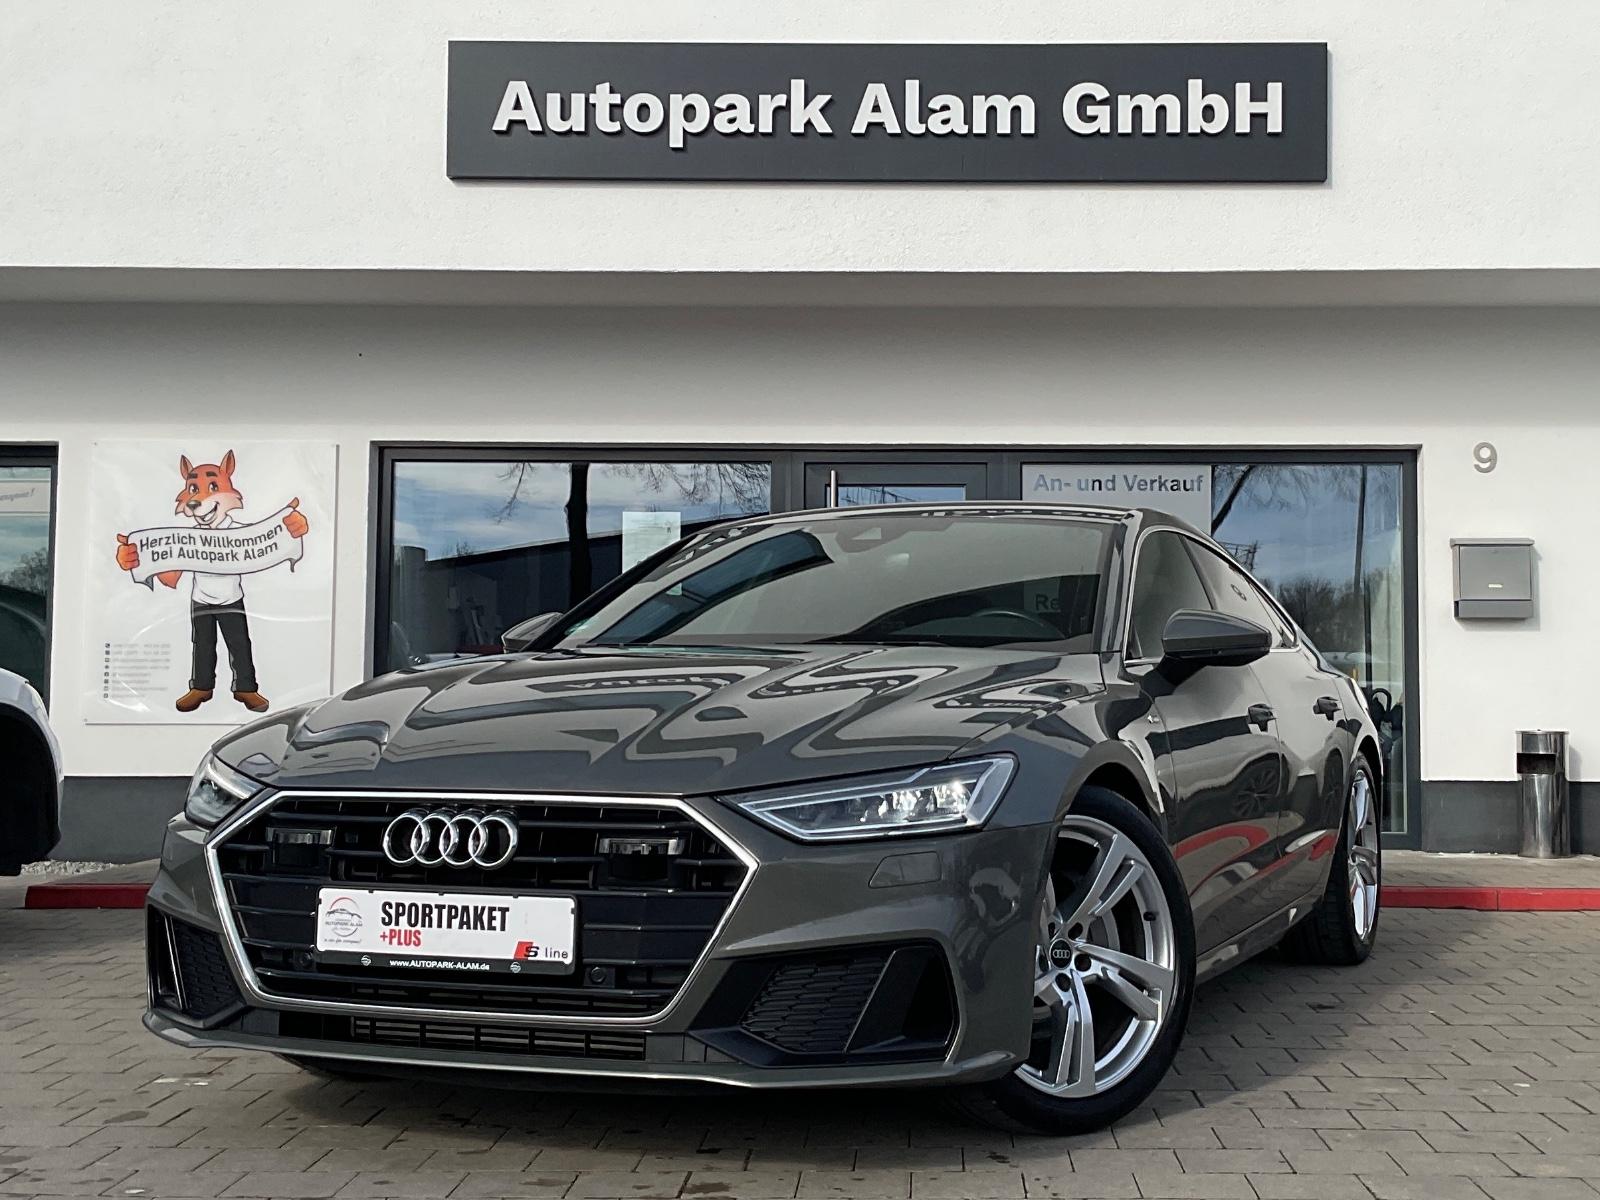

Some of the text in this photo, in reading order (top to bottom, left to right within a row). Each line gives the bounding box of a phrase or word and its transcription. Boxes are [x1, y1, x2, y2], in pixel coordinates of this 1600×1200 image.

[492, 78, 1284, 149] Autopark Alam GmbH
[1473, 441, 1498, 474] 9
[1033, 474, 1205, 492] An- und Verkauf
[139, 523, 283, 552] Herzlich Willkommen
[151, 541, 279, 563] bei Autopark Alam
[381, 901, 510, 931] SPORTPAKET
[380, 928, 422, 947] +PLUS
[523, 946, 569, 959] S line
[389, 959, 490, 971] www.AUTOPARK-ALAM.de
